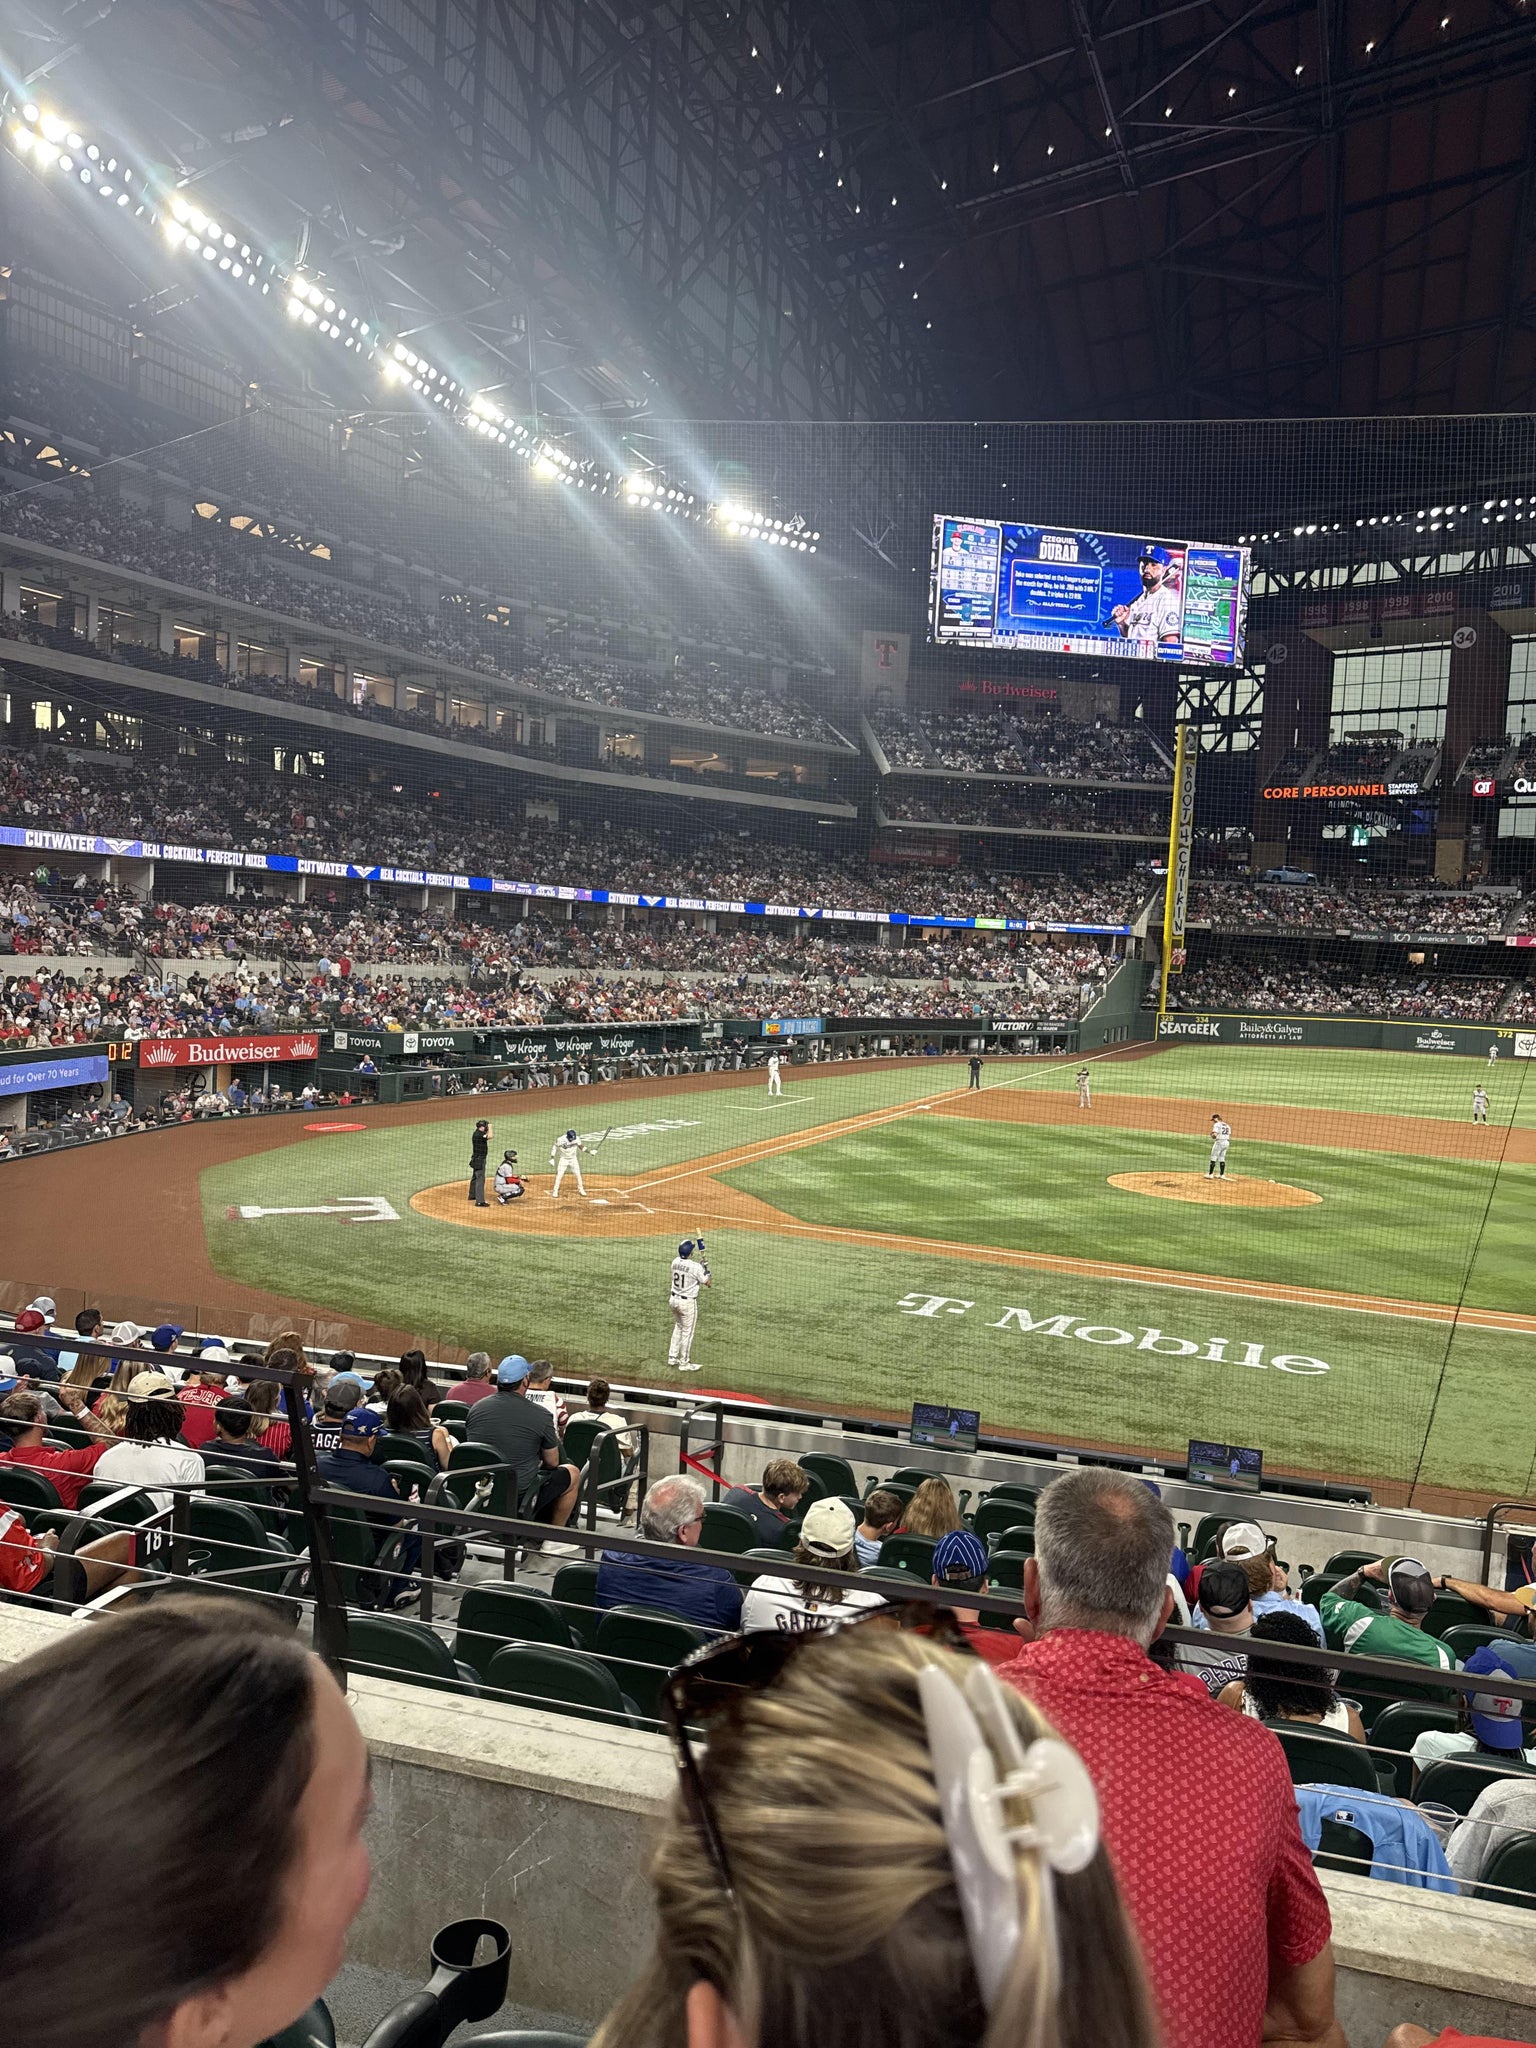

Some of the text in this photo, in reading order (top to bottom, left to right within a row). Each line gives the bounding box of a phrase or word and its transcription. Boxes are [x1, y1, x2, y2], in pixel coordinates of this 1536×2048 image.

[1042, 535, 1077, 545] EZEQUIEL
[1039, 542, 1079, 562] DURAN
[1454, 631, 1476, 645] 34
[875, 639, 898, 669] T
[1269, 647, 1286, 661] 42
[1263, 784, 1387, 799] CORE PERSONNEL
[1474, 782, 1492, 794] QT
[25, 831, 96, 852] CUTWATER
[142, 843, 162, 858] REAL
[163, 845, 204, 862] COCKTAILS.
[206, 849, 244, 867] PERFECTLY
[298, 859, 348, 877] CUTWATER
[380, 868, 394, 881] REAL
[426, 873, 453, 886] PERFECTLY
[608, 892, 639, 905] CUTWATER
[765, 904, 800, 917] CUTWATER
[1215, 925, 1239, 933] SHIFT
[1277, 928, 1300, 936] SHIFT
[1418, 935, 1448, 943] American
[991, 1021, 1032, 1031] VICTORY
[1159, 1022, 1220, 1036] SEATGEEK
[1240, 1021, 1303, 1035] Bailey&Galyen
[1497, 1030, 1514, 1038] 372
[349, 1037, 382, 1049] TOYOTA
[421, 1037, 455, 1048] TOYOTA
[517, 1038, 547, 1060] Kroger
[566, 1036, 593, 1056] Kroger
[610, 1035, 634, 1055] Kroger
[1416, 1036, 1456, 1047] Budweiser
[108, 1042, 132, 1061] 0 12
[188, 1042, 281, 1063] Budweiser
[13, 1074, 25, 1084] for
[26, 1072, 46, 1082] Over
[48, 1069, 57, 1079] 70
[60, 1067, 79, 1078] Years
[673, 1272, 685, 1289] 21
[896, 1292, 1331, 1376] T Mobile
[311, 1433, 343, 1450] AGE
[145, 1526, 162, 1556] 18
[1493, 1697, 1513, 1714] T
